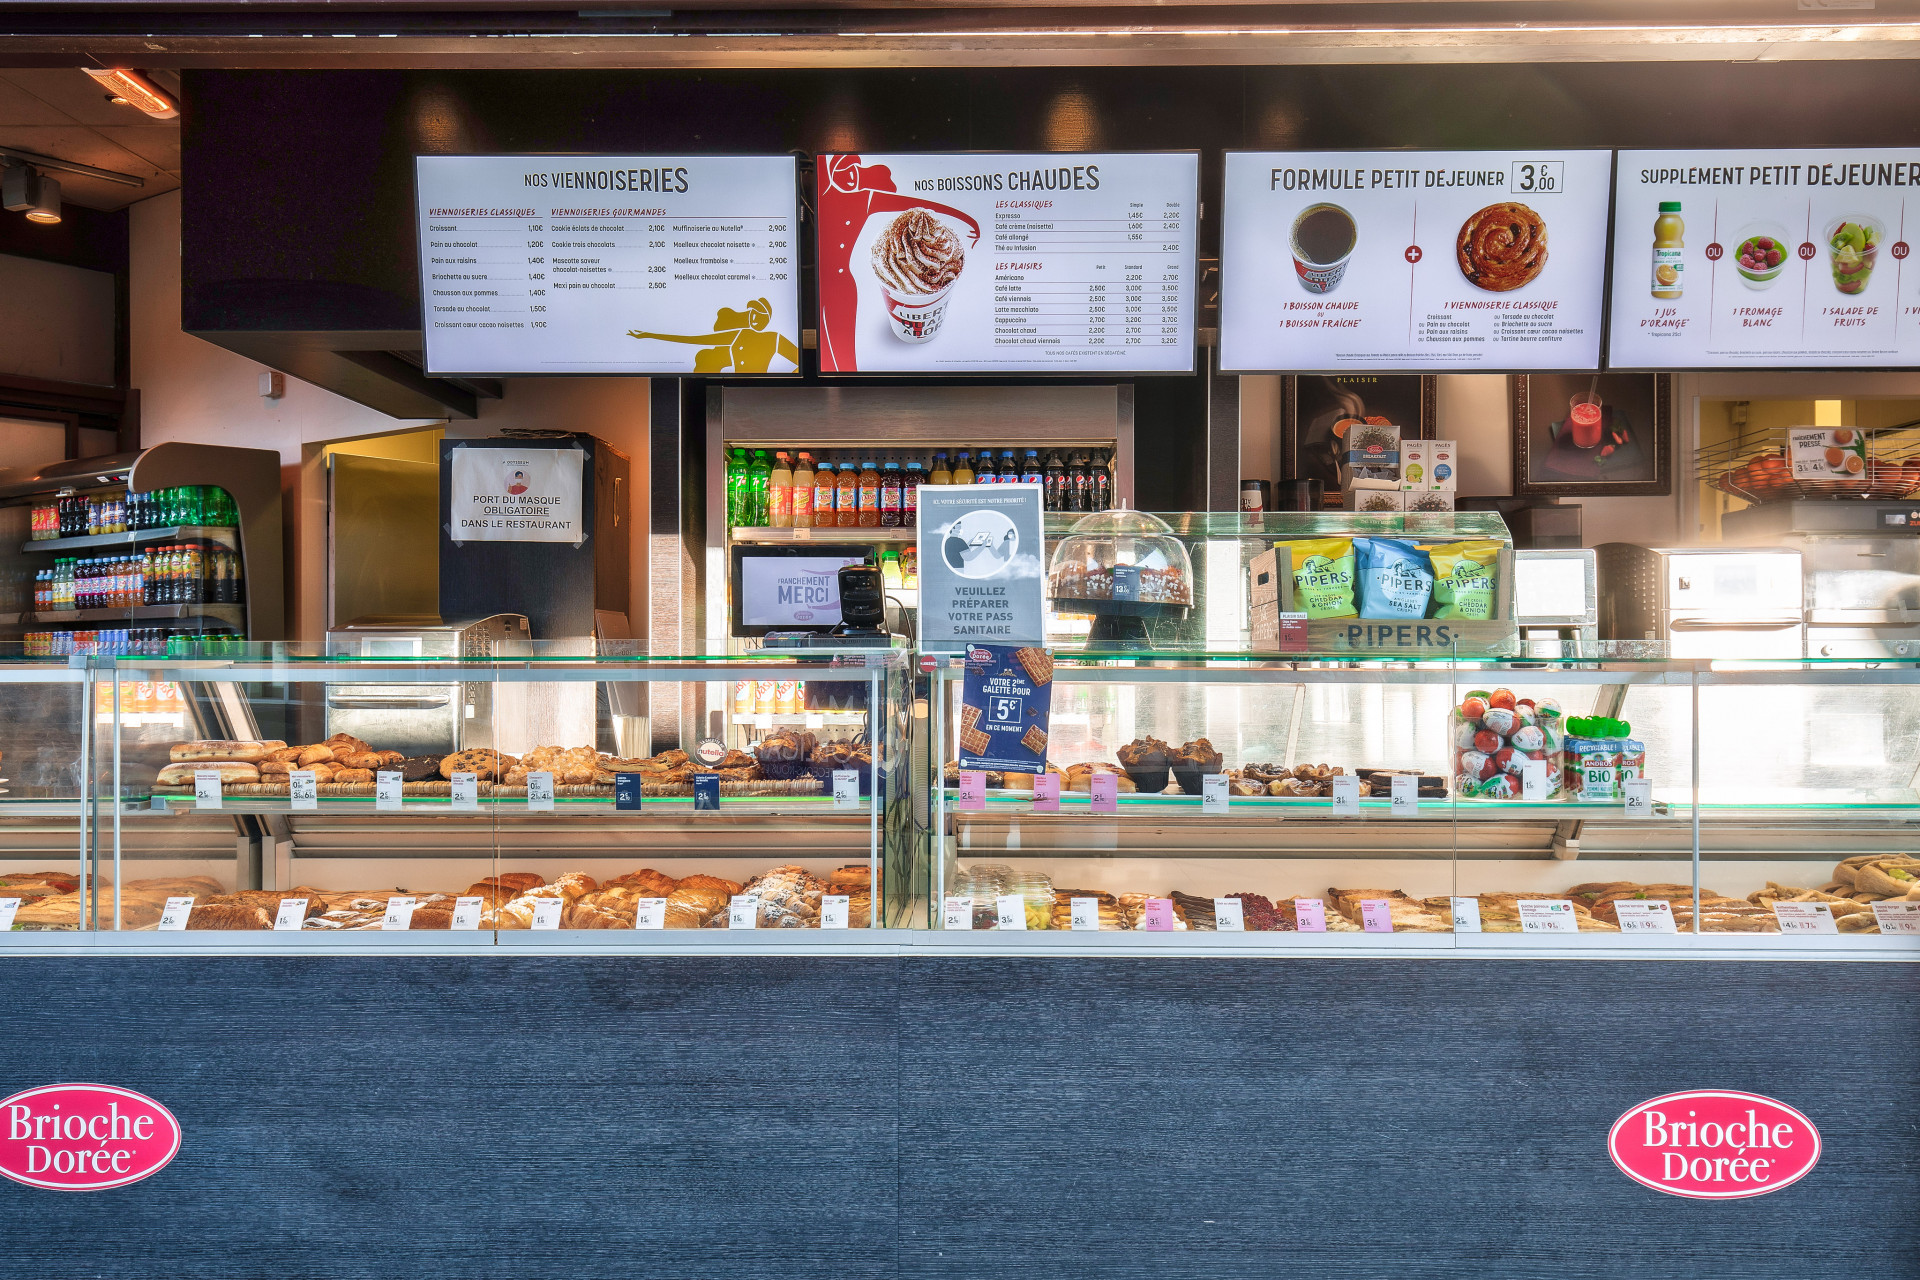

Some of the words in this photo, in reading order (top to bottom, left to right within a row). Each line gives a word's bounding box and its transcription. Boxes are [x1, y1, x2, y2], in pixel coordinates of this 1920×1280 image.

[915, 180, 934, 191] NOS
[938, 174, 1002, 191] BOISSONS
[1008, 166, 1099, 190] CHAUDES
[1271, 169, 1364, 190] FORMULE
[1372, 170, 1420, 188] PETIT
[1425, 169, 1504, 187] DÉJEUNER
[1641, 167, 1744, 184] SUPPLÉMENT
[1750, 166, 1801, 185] PETIT
[1808, 163, 1920, 186] DÉJEUNER
[525, 174, 548, 187] NOS
[552, 167, 688, 193] VIENNOISERIES
[1010, 201, 1052, 210] CLASSIQUES
[1708, 247, 1721, 256] OU
[1801, 246, 1813, 256] OU
[1894, 246, 1907, 255] OU
[1513, 301, 1558, 311] CLASSIQUE
[1830, 307, 1864, 315] SALADE
[1740, 308, 1782, 317] FROMAGE
[1743, 319, 1772, 327] BLANC
[474, 496, 499, 504] PORT
[484, 506, 549, 515] OBLIGATOIRE
[778, 576, 830, 586] FRANCHEMENT
[1295, 572, 1348, 587] PIPERS
[1382, 574, 1431, 592] PIPERS
[1446, 578, 1496, 589] PIPERS
[778, 586, 828, 604] MERCI
[955, 587, 1005, 595] VEUILLEZ
[952, 597, 1008, 608] PRÉPARER
[948, 612, 982, 620] VOTRE
[954, 626, 1010, 634] SANITAIRE
[1348, 625, 1451, 647] PIPERS
[990, 678, 1010, 686] VOTRE
[983, 686, 1010, 694] GALETTE
[8, 1102, 154, 1140] Brioche
[1643, 1110, 1793, 1148] Brioche
[26, 1140, 130, 1174] Dorée
[1662, 1148, 1770, 1182] Dorée
